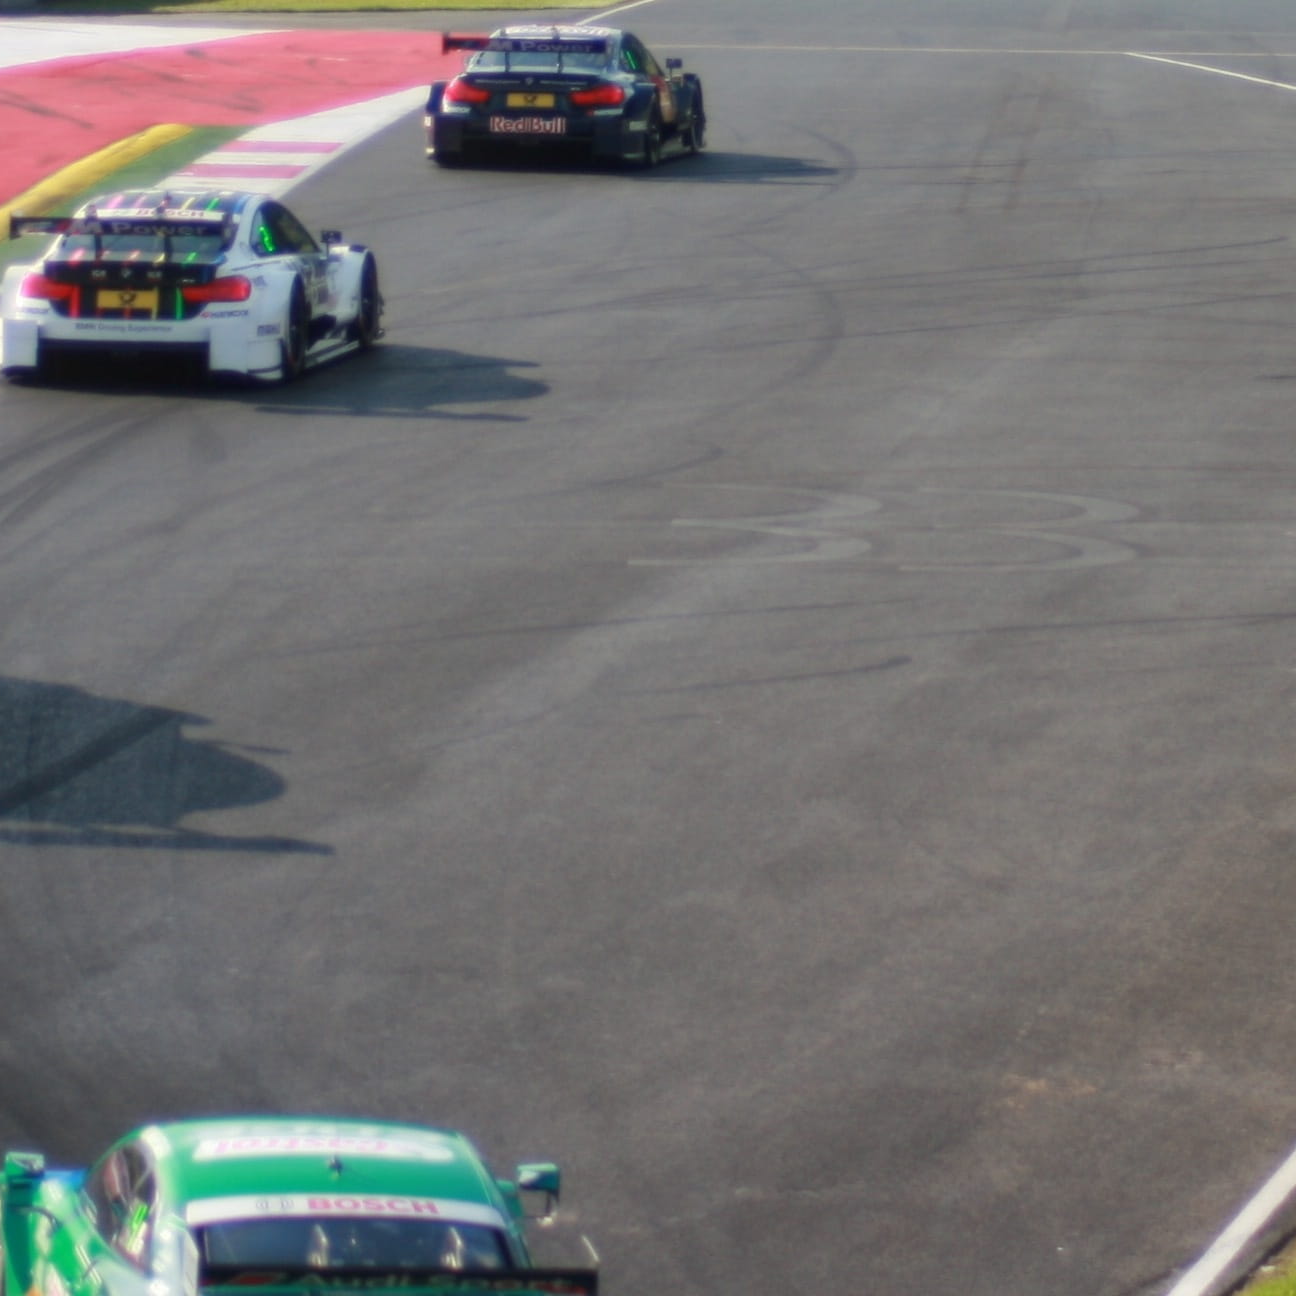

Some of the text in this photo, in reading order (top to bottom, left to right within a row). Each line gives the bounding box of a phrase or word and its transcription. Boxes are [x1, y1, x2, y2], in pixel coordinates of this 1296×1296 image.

[490, 117, 566, 134] Red Bull
[306, 1198, 440, 1215] BOSCH
